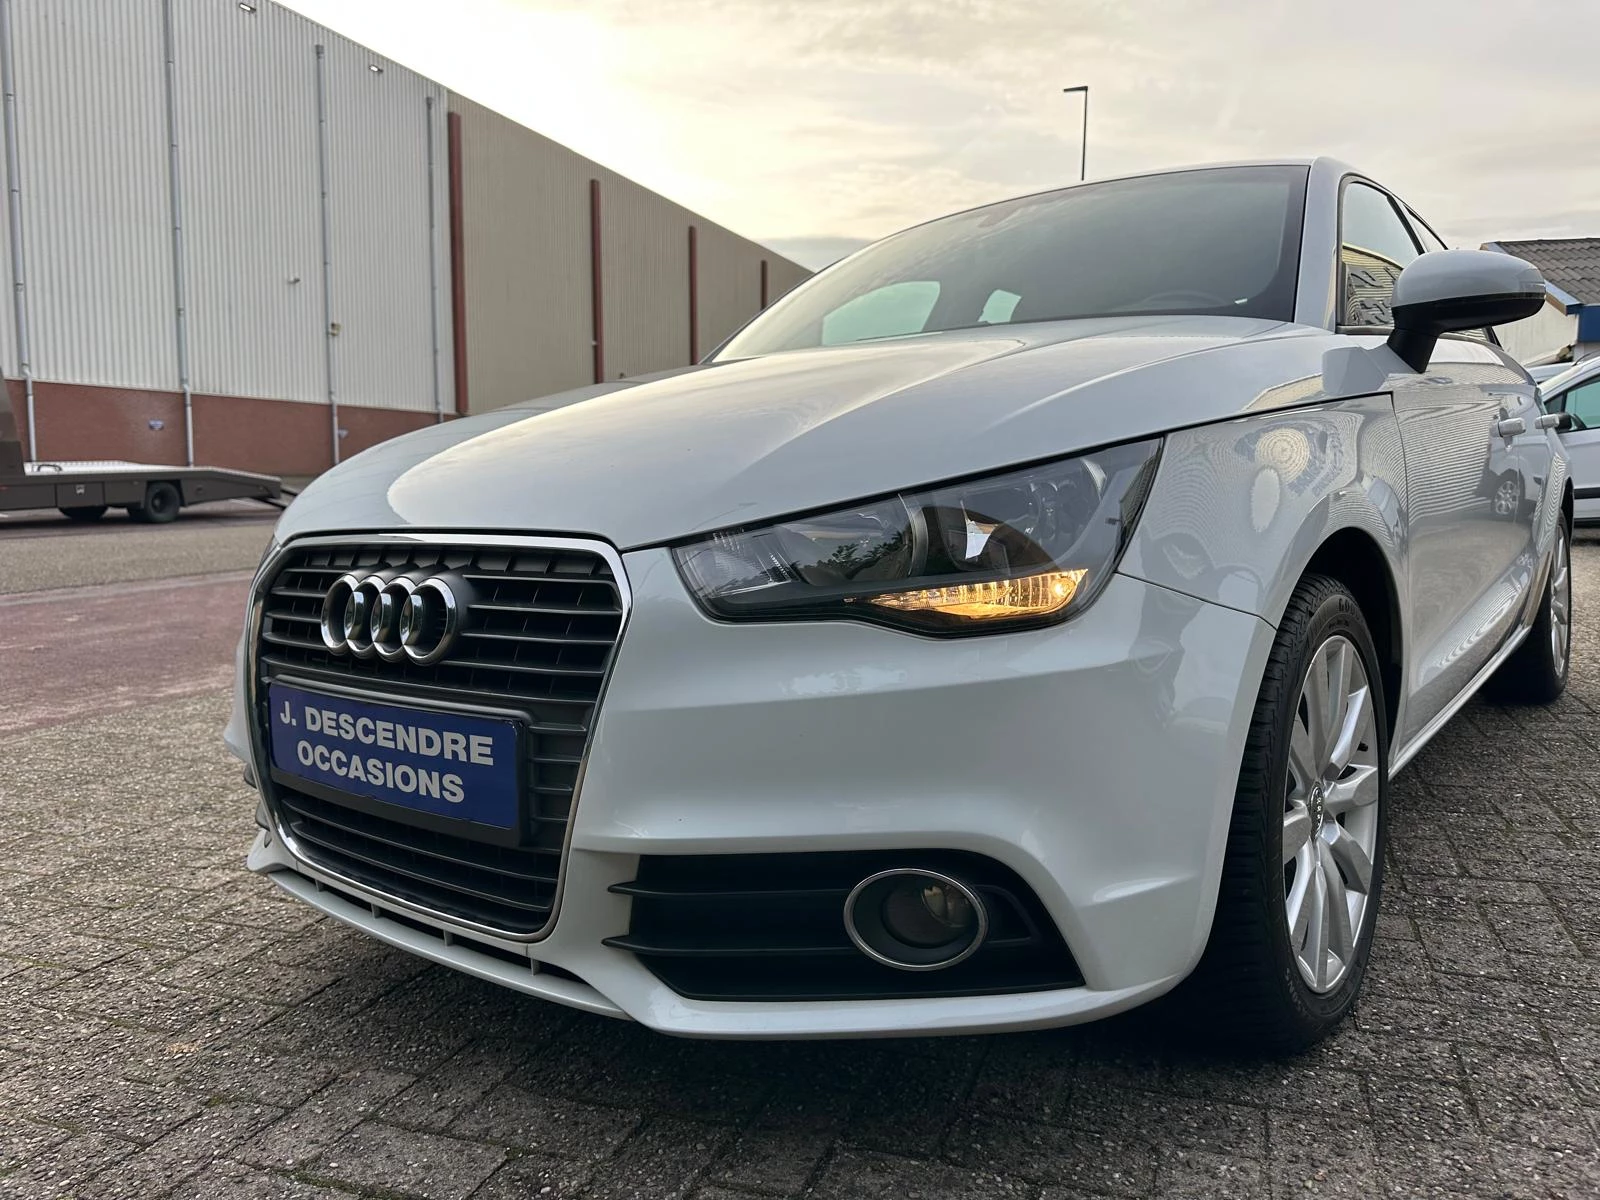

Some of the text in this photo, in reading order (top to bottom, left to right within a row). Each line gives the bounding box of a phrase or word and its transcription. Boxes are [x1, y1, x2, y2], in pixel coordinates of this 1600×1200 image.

[279, 701, 494, 766] J. DESCENDRE
[297, 740, 465, 803] OCCASIONS
